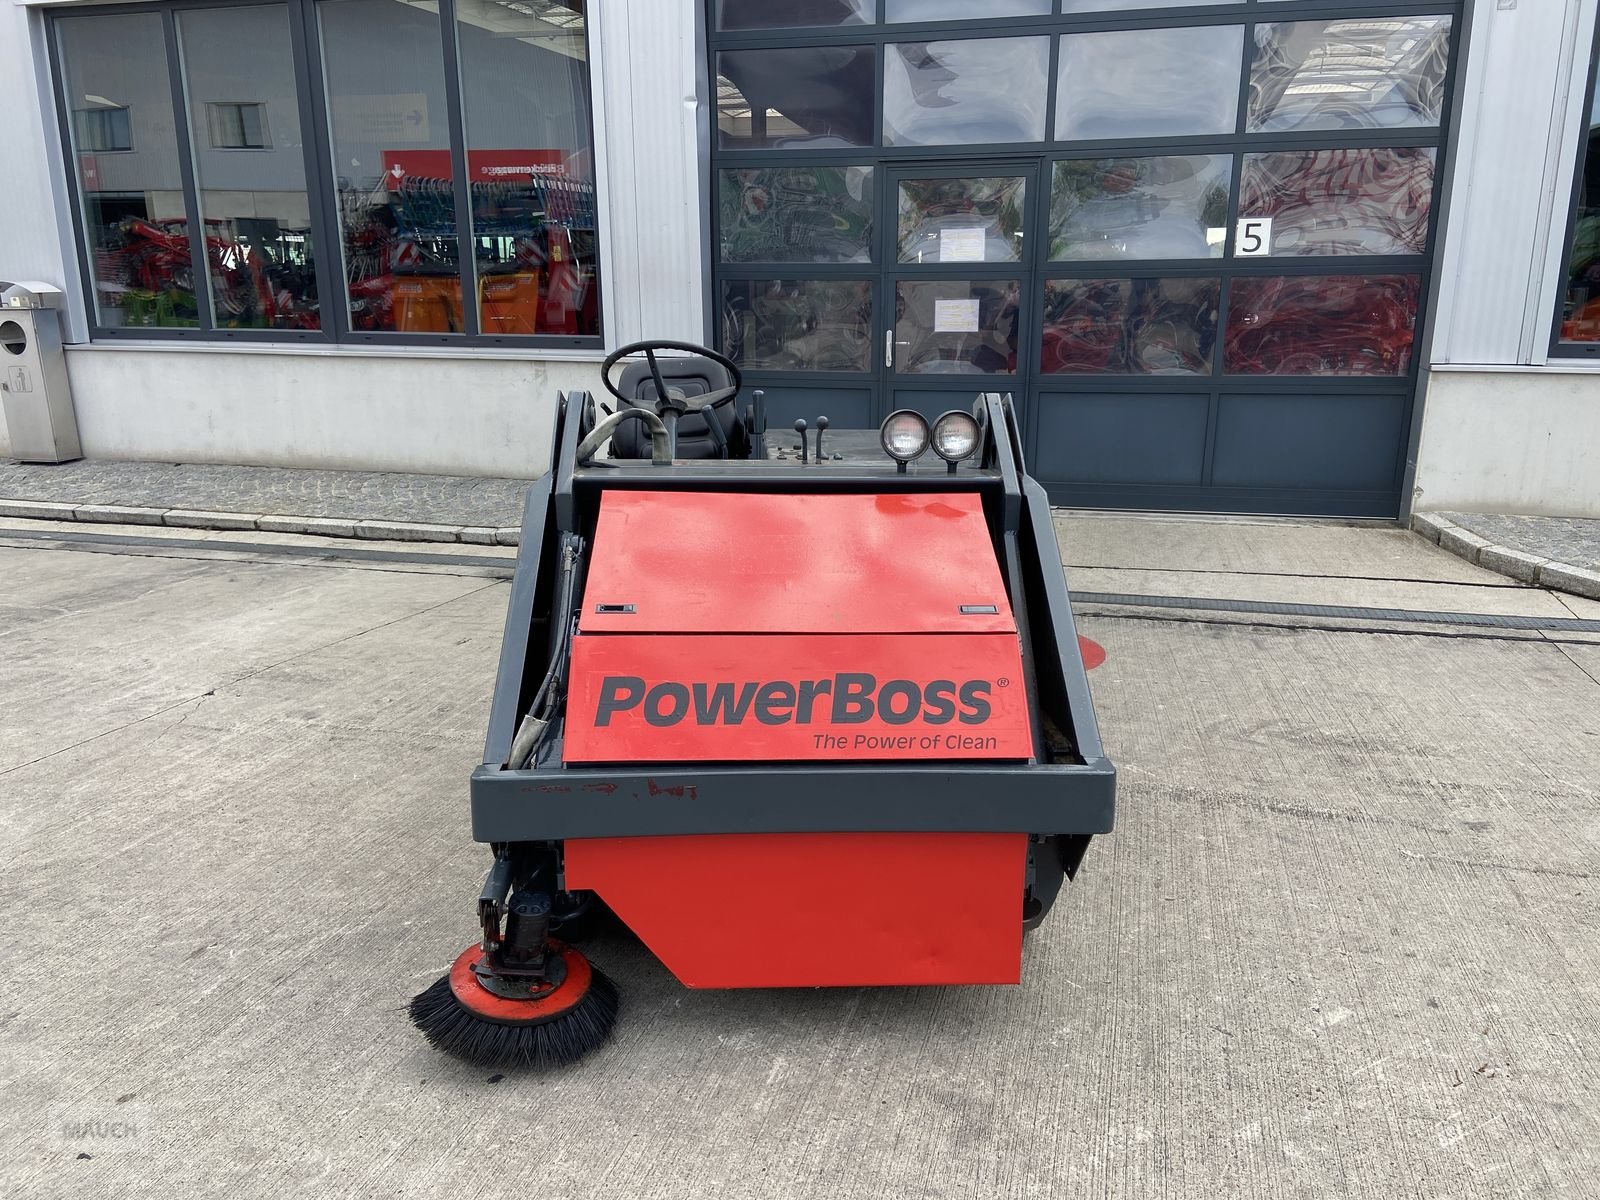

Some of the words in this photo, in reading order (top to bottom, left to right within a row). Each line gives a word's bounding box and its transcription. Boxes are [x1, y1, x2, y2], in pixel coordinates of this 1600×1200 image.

[1242, 223, 1262, 253] 5
[814, 734, 848, 749] The
[854, 734, 916, 750] Power
[919, 734, 941, 750] of
[945, 734, 997, 750] Clean
